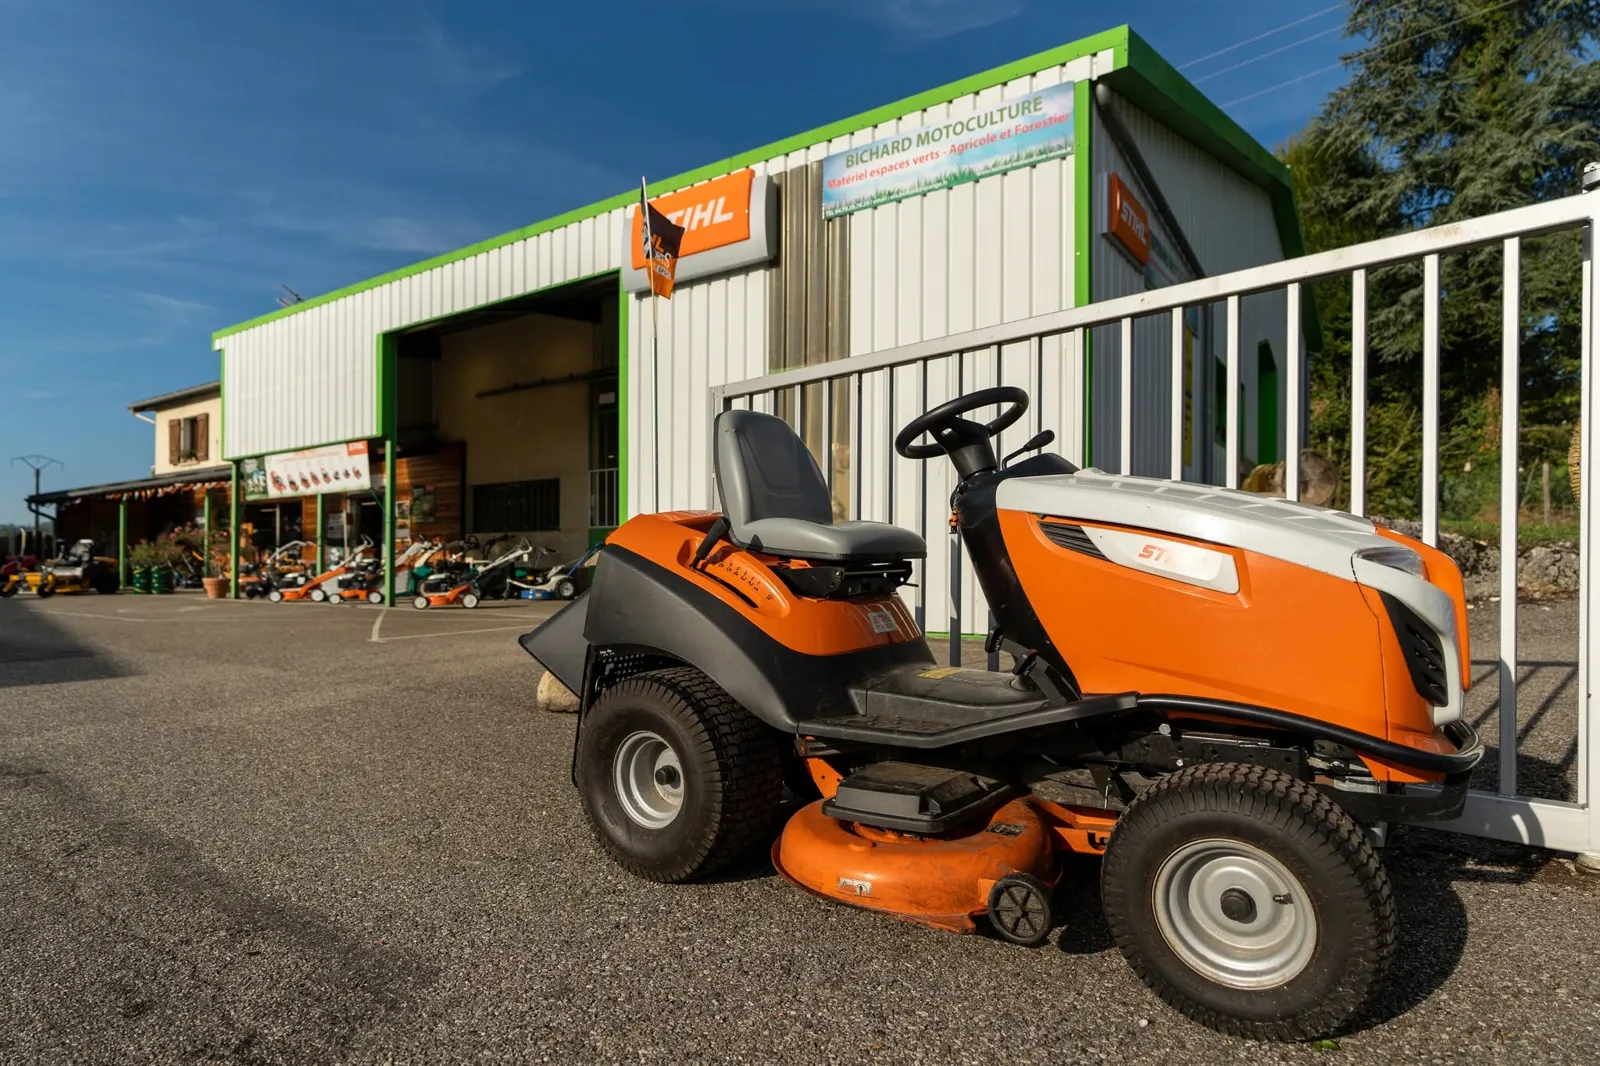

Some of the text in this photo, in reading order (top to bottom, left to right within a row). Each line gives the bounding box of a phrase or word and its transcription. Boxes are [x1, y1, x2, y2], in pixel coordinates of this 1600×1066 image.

[845, 96, 1043, 168] BICHARD MOTOCULTURE
[870, 158, 909, 177] espaces
[912, 149, 940, 165] verts
[949, 132, 997, 155] Agricole
[999, 129, 1011, 140] et
[1014, 111, 1071, 136] Forestier
[666, 196, 734, 232] TIHL
[1120, 200, 1147, 245] STIHL
